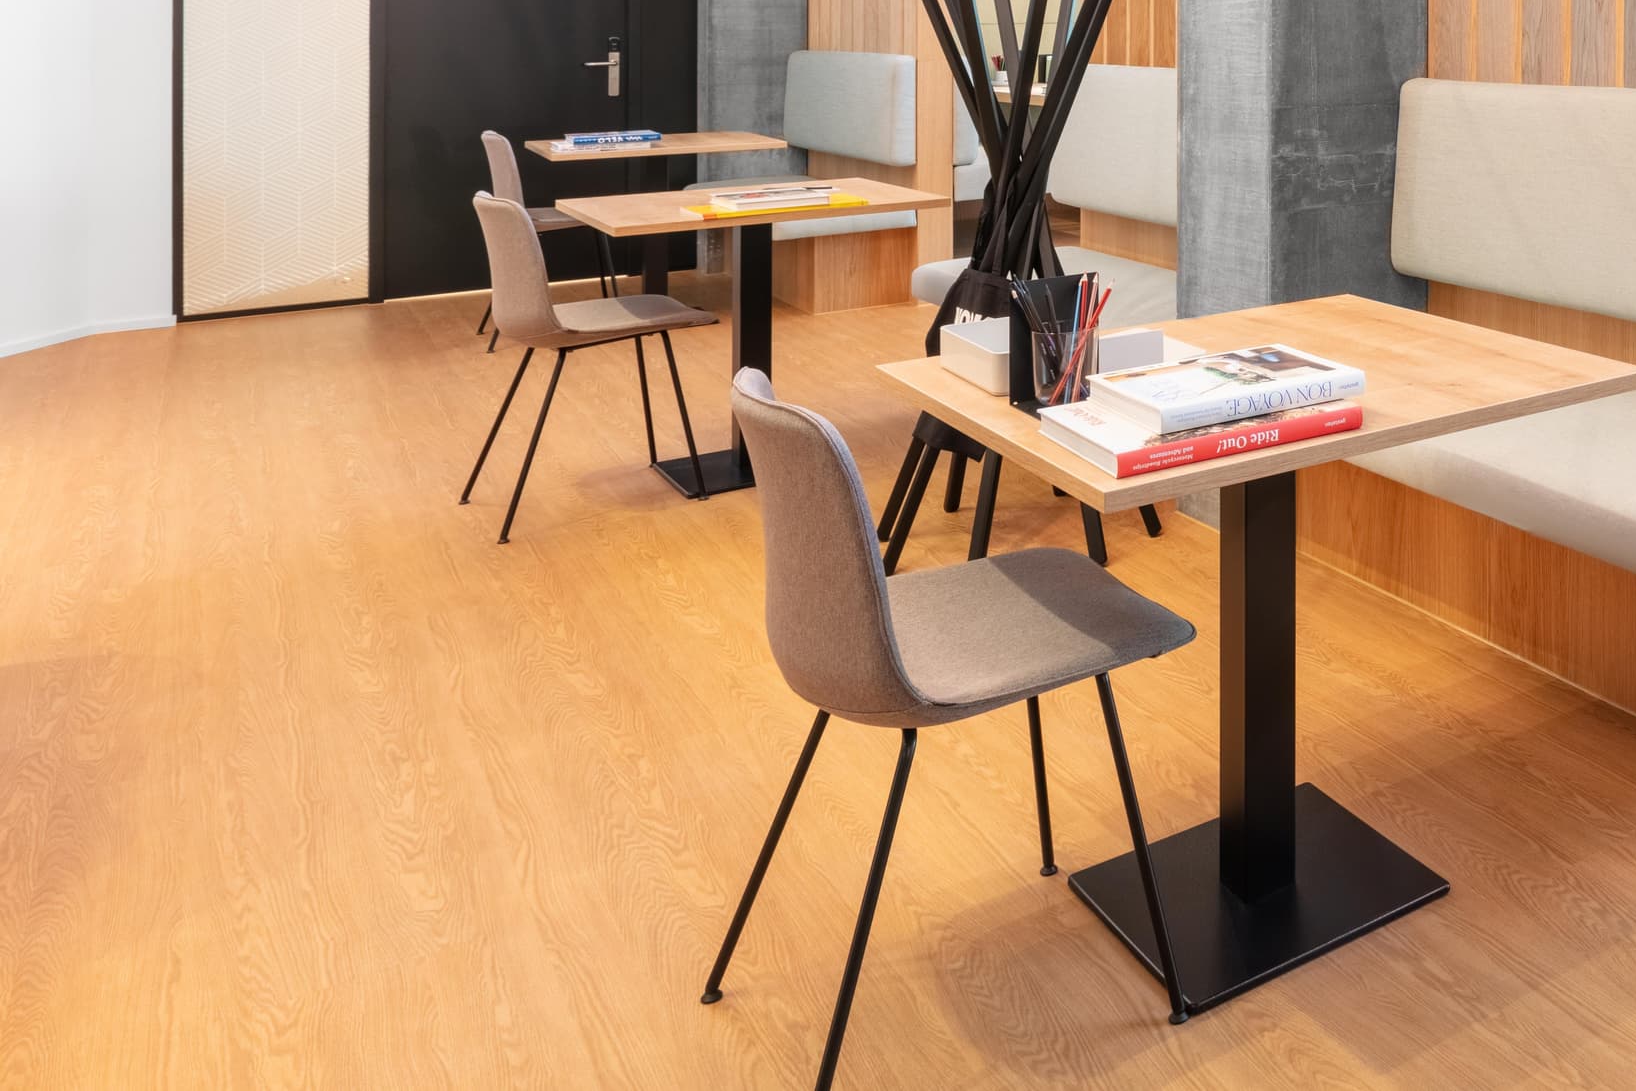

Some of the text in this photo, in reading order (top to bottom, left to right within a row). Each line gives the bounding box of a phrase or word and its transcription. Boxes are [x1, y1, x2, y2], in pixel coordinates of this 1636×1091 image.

[1226, 389, 1293, 417] VOYAGE
[1297, 381, 1332, 404] BON
[1216, 429, 1279, 453] Ride Out!
